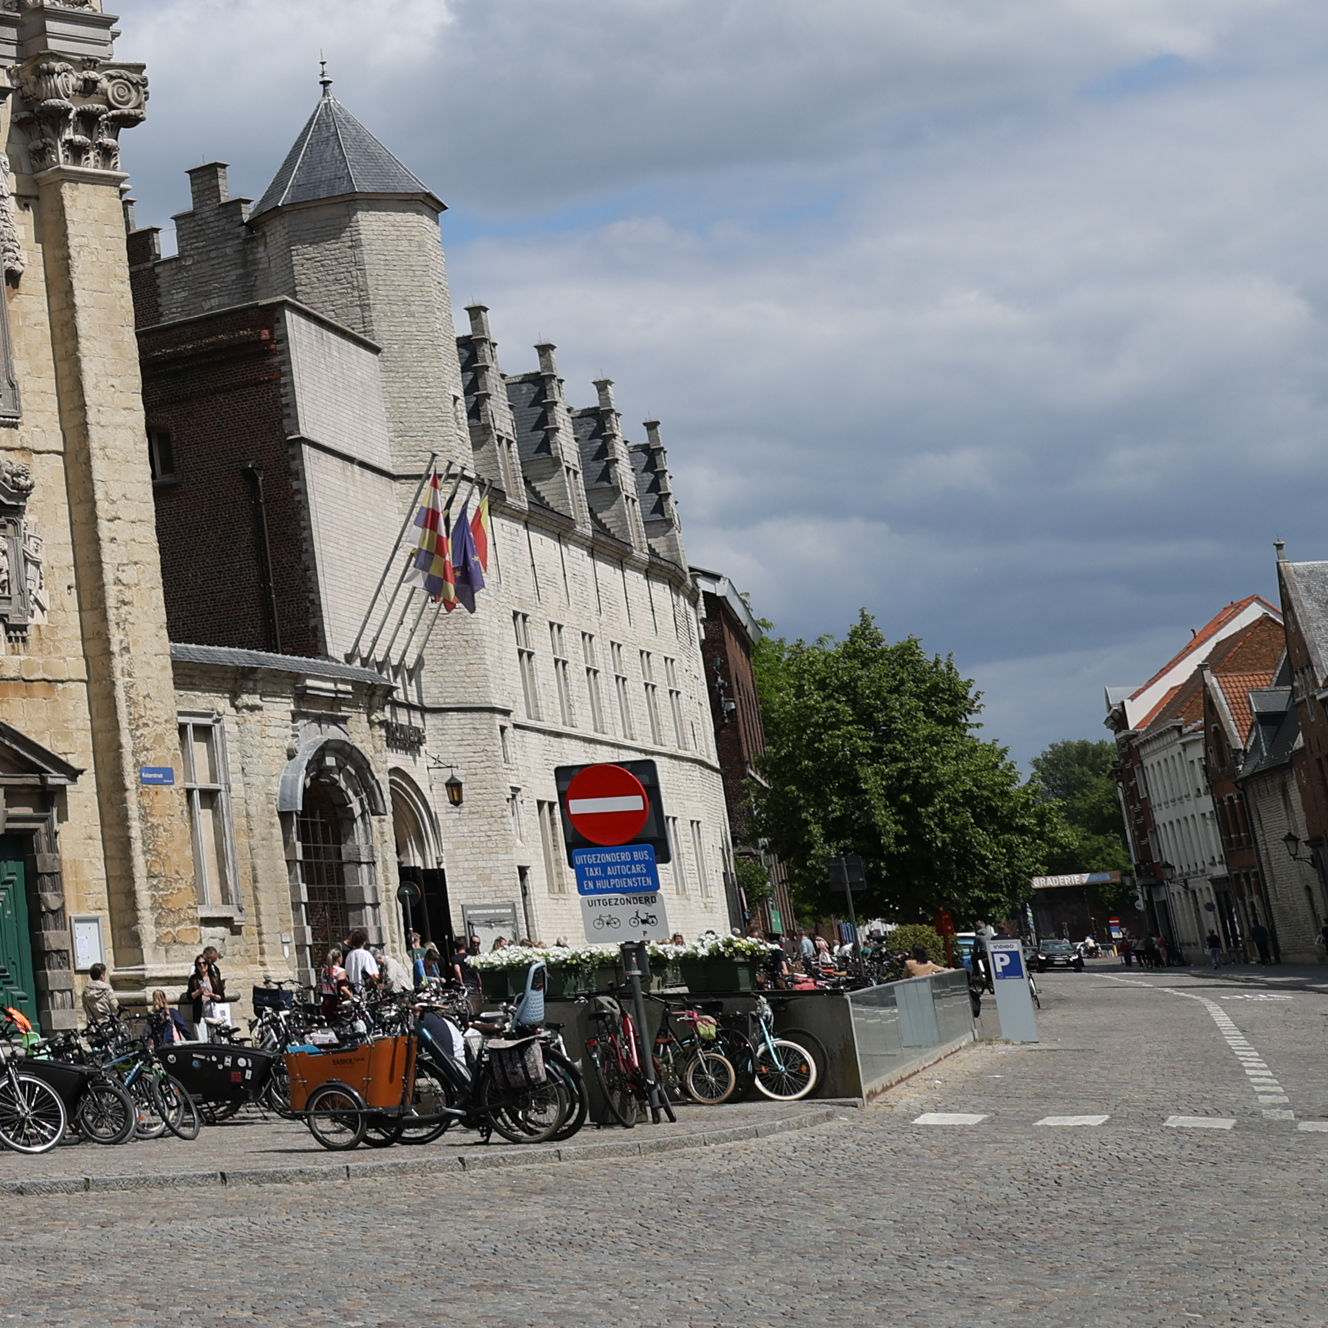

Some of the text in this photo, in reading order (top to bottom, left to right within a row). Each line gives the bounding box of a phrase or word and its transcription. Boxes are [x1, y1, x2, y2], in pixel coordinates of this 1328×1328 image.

[575, 850, 653, 865] UITGEZONDERD BUS,
[584, 864, 647, 877] TAXI, AUTOCARS
[583, 876, 653, 890] EN HULPDIENSTEN
[1033, 875, 1080, 887] BRADERIE
[587, 895, 657, 908] UITGEZONDERD
[993, 953, 1011, 973] P
